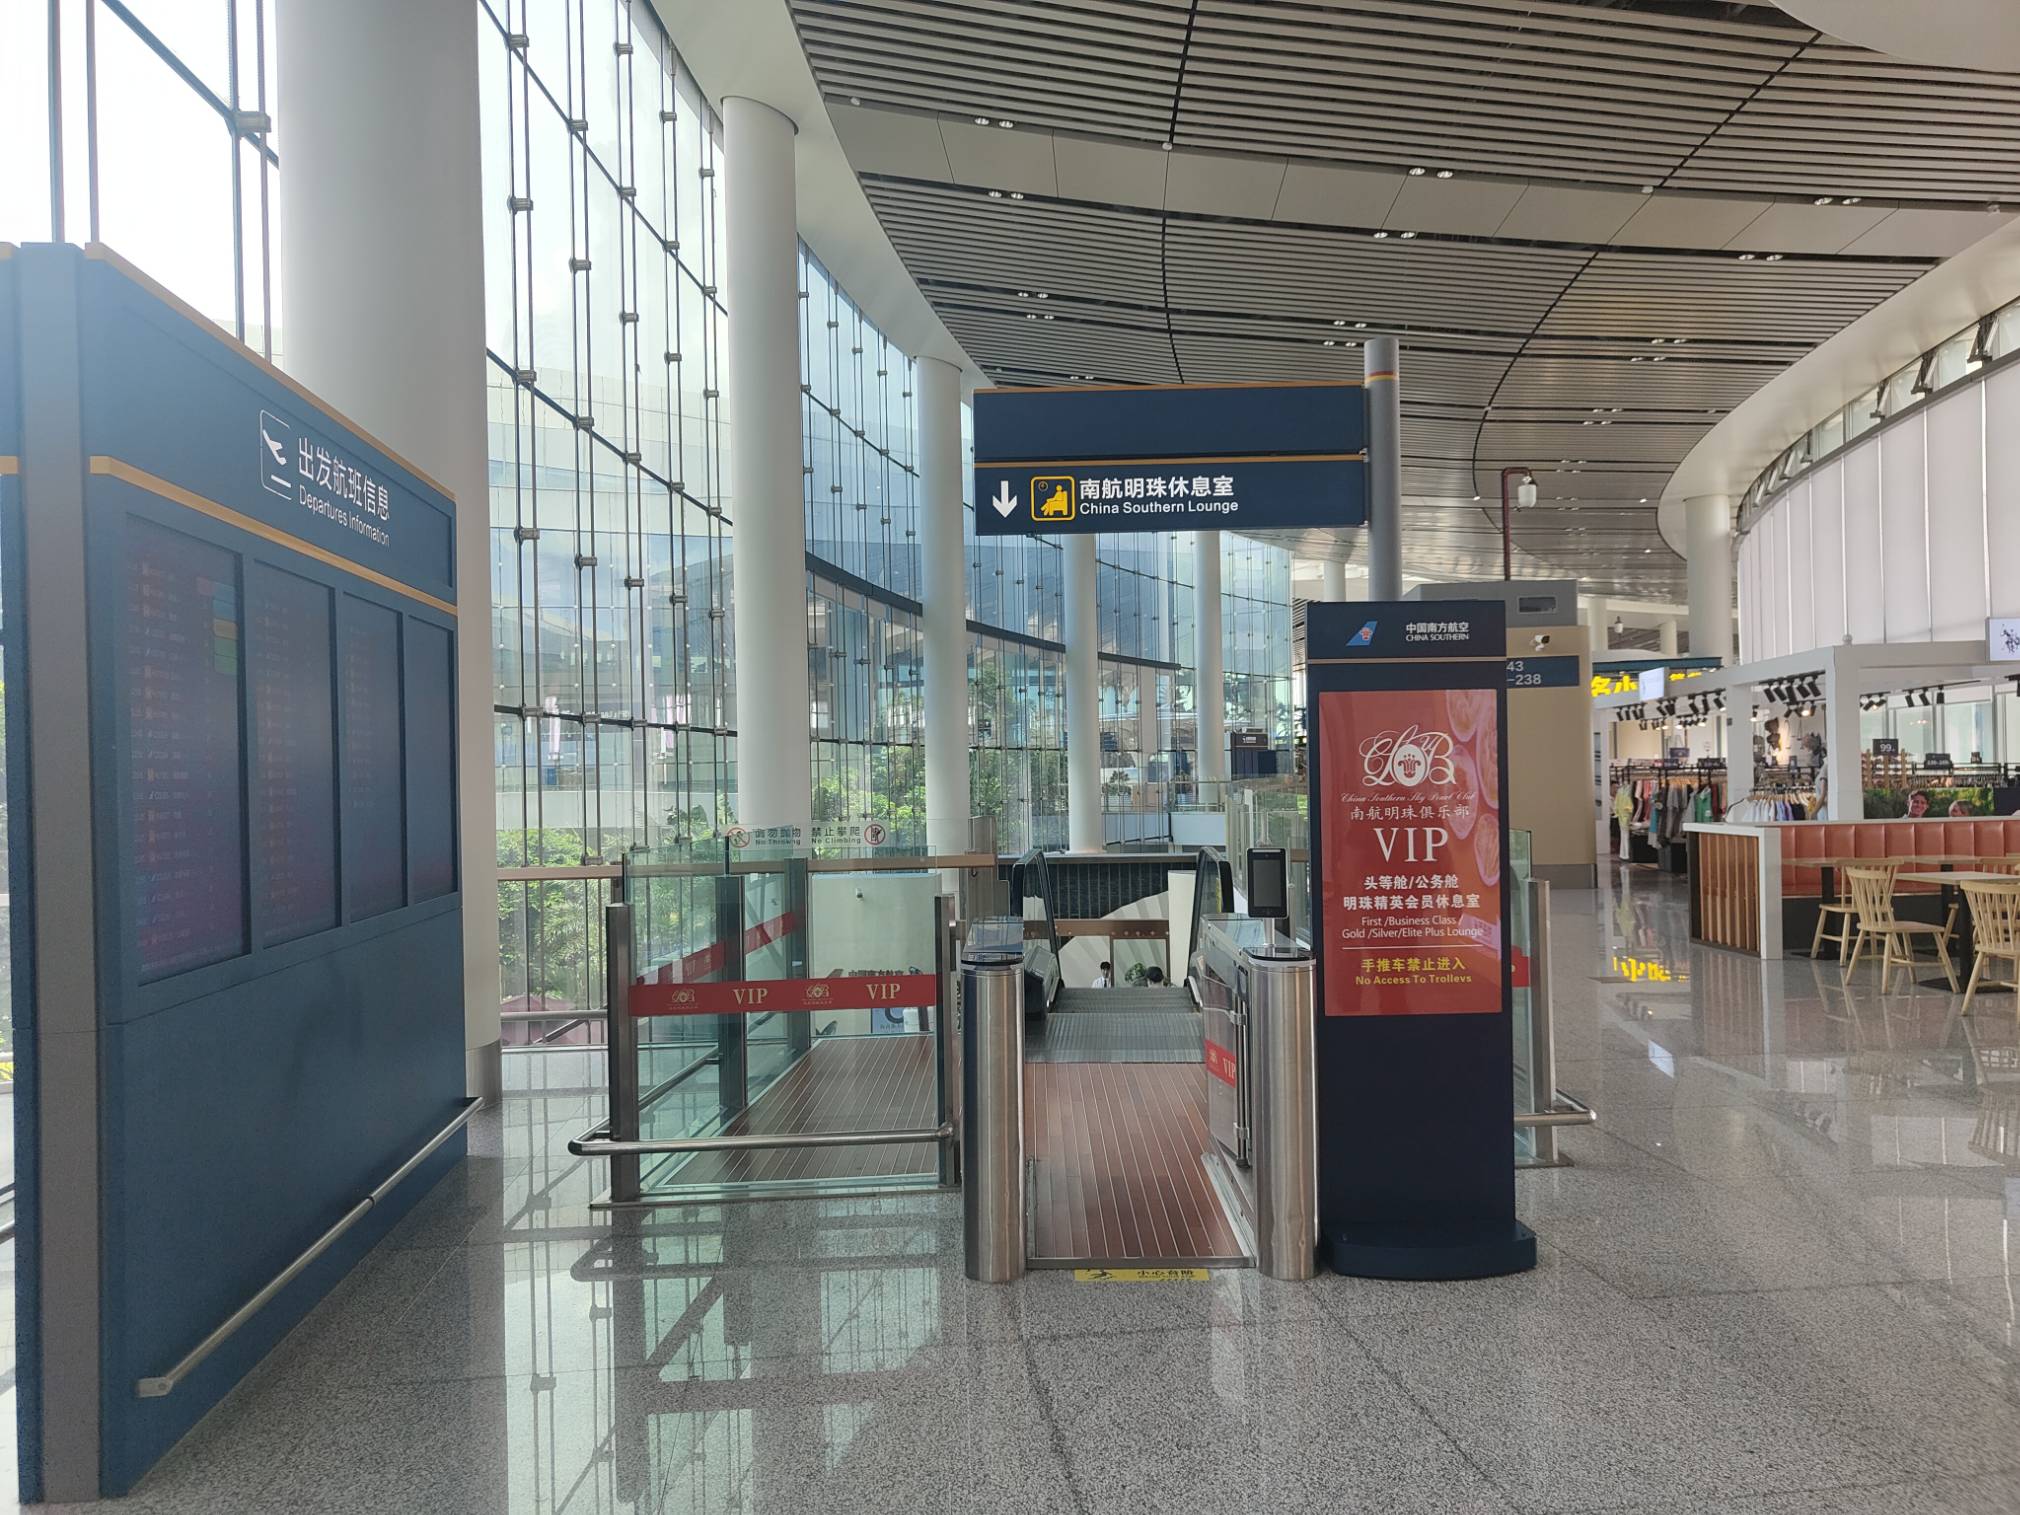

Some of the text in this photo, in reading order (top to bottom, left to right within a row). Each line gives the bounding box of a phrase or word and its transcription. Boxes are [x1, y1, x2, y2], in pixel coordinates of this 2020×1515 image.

[299, 437, 390, 521] 出发航班信息
[1079, 476, 1234, 500] 南航明珠休息室
[1080, 500, 1239, 515] China Southern Lounge
[300, 485, 390, 547] Departures Information
[1406, 622, 1469, 634] 中国南方航空
[1430, 633, 1469, 641] SOUTHERN
[1506, 661, 1524, 672] 43
[1341, 792, 1366, 803] China
[1350, 803, 1470, 821] 南航明珠俱乐部
[1372, 826, 1449, 862] VIP
[1364, 874, 1459, 890] 头等舱/公务舱
[1343, 894, 1481, 911] 明珠精英会员休息室
[1361, 916, 1382, 927] First
[1384, 914, 1430, 927] /Business
[1432, 914, 1457, 926] Class
[1342, 928, 1366, 939] Gold
[1425, 926, 1445, 938] Plus
[1447, 924, 1484, 938] Lounge
[1361, 957, 1466, 973] 手推车禁止进入
[1355, 976, 1371, 985] No
[1373, 976, 1411, 985] Access
[1413, 975, 1426, 984] To
[733, 988, 768, 1004] VIP
[866, 983, 901, 1000] VIP
